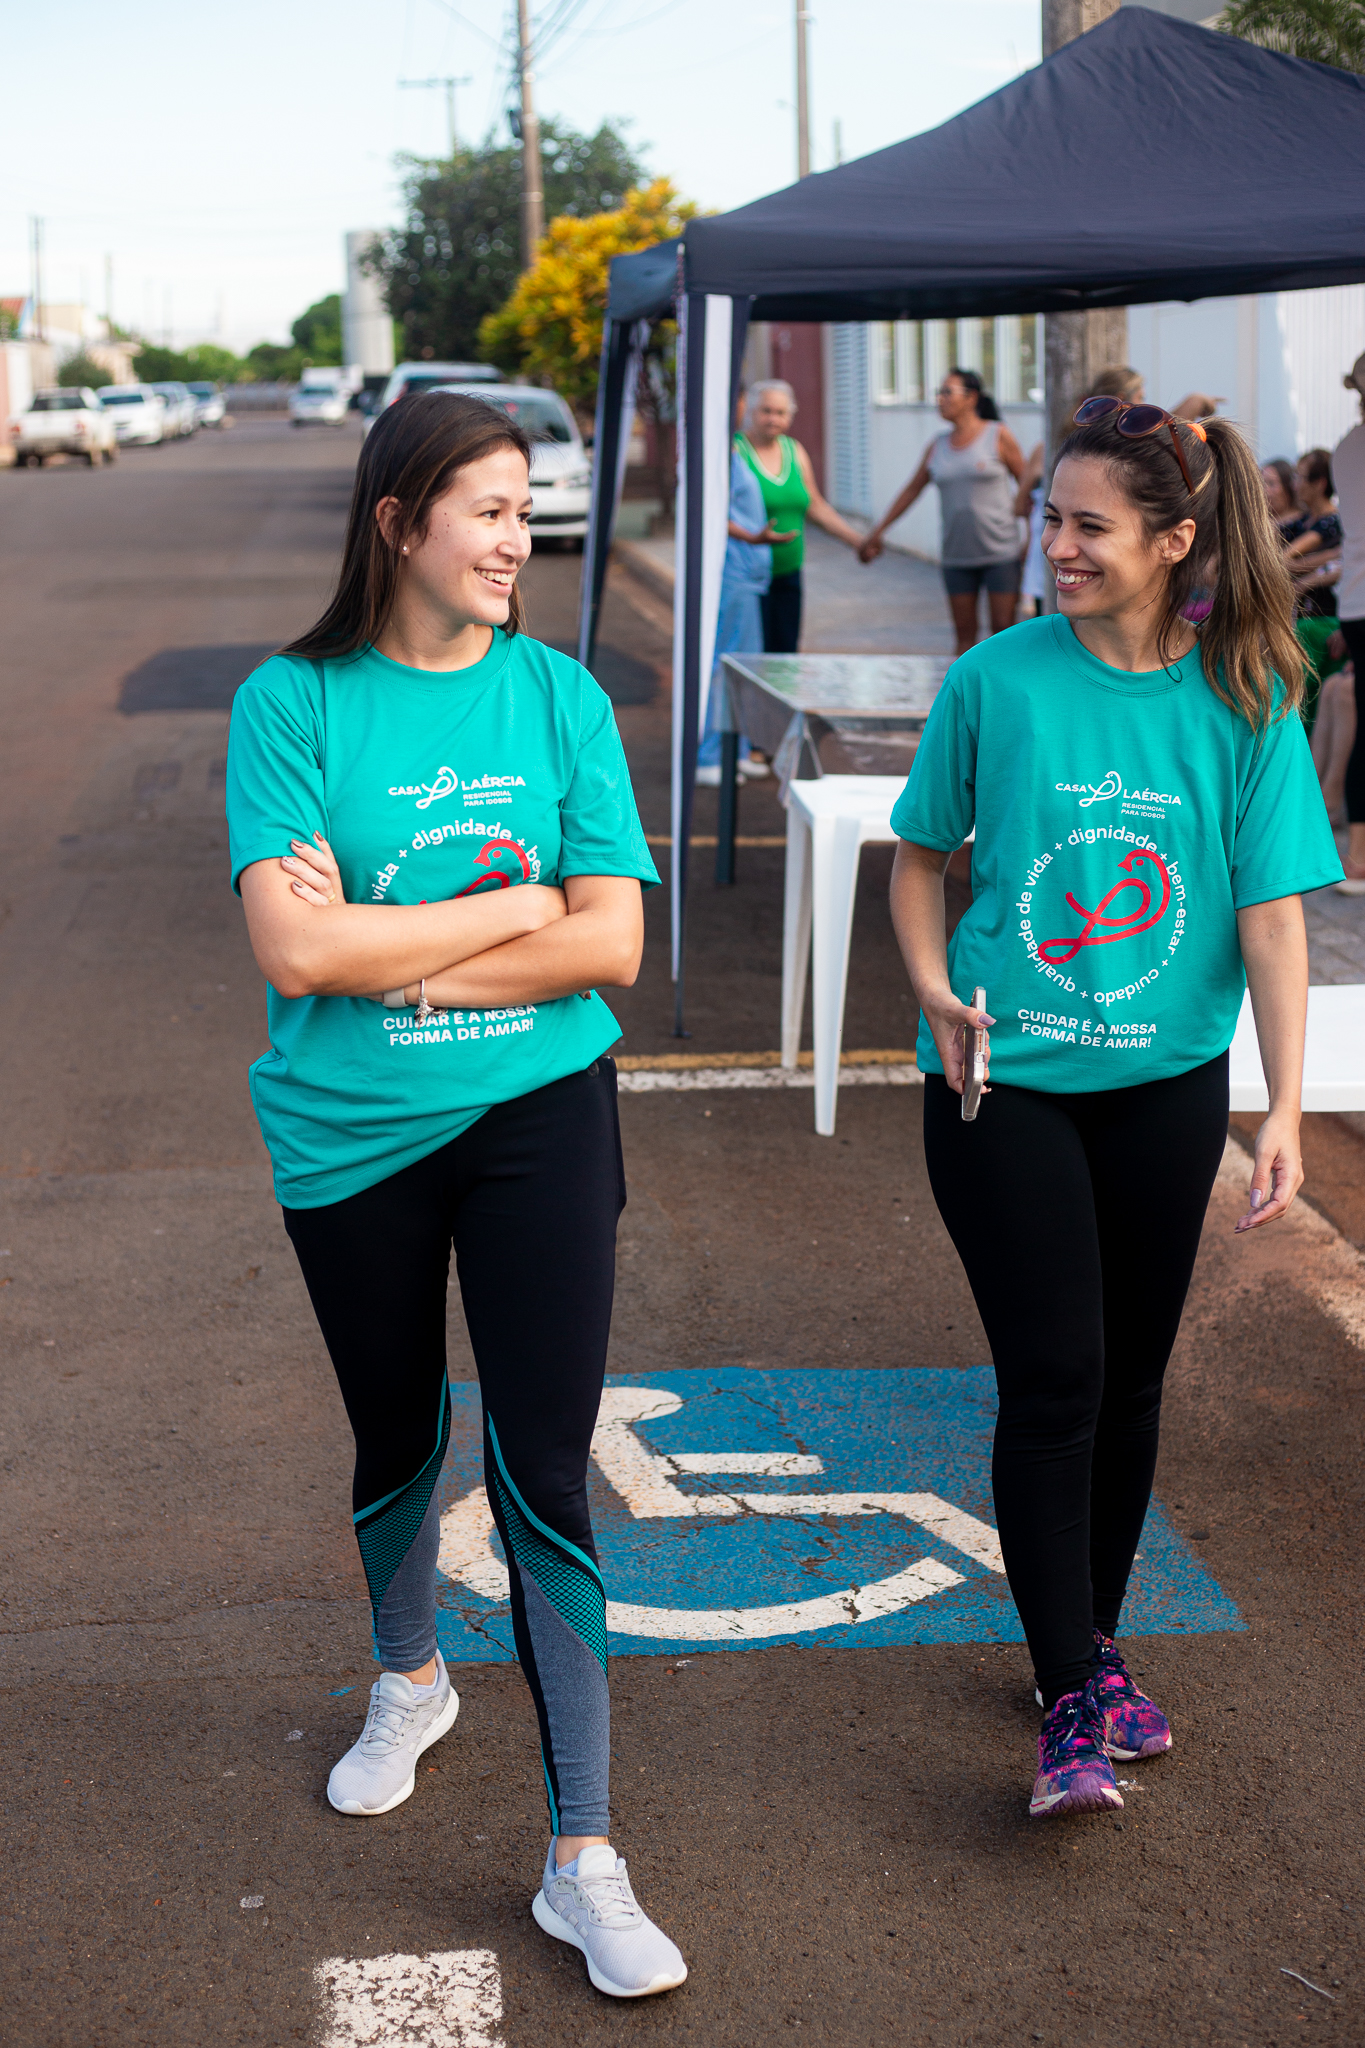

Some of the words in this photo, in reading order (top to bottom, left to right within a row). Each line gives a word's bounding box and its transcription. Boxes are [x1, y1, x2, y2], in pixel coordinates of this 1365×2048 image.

[388, 786, 422, 796] CASA
[461, 774, 526, 791] LAÉRCIA
[463, 790, 512, 800] RESIDENCIAL
[1055, 783, 1087, 793] CASA
[1123, 788, 1182, 805] LAÉRCIA
[464, 799, 485, 807] PARA
[486, 797, 513, 805] IDOSOS
[1122, 802, 1166, 812] RESIDENCIAL
[1140, 811, 1165, 819] IDOSOS
[1067, 825, 1158, 853] dignidade
[372, 862, 400, 900] vida
[411, 818, 512, 850] dignidade
[1025, 853, 1054, 887] vida
[1016, 891, 1032, 914] de
[1165, 861, 1187, 956] bem-estar
[1018, 919, 1076, 992] qualidade
[1094, 968, 1159, 1007] cuidado
[453, 1010, 465, 1025] É
[468, 1012, 481, 1023] A
[484, 1004, 537, 1022] NOSSA
[1017, 1008, 1078, 1029] CUIDAR
[1081, 1019, 1092, 1032] É
[1094, 1023, 1105, 1034] A
[1109, 1024, 1157, 1034] NOSSA
[389, 1029, 453, 1046] FORMA
[456, 1026, 480, 1040] DE
[484, 1018, 534, 1038] AMAR!
[1021, 1022, 1076, 1044] FORMA
[1080, 1035, 1102, 1047] DE
[1104, 1037, 1152, 1048] AMAR!
